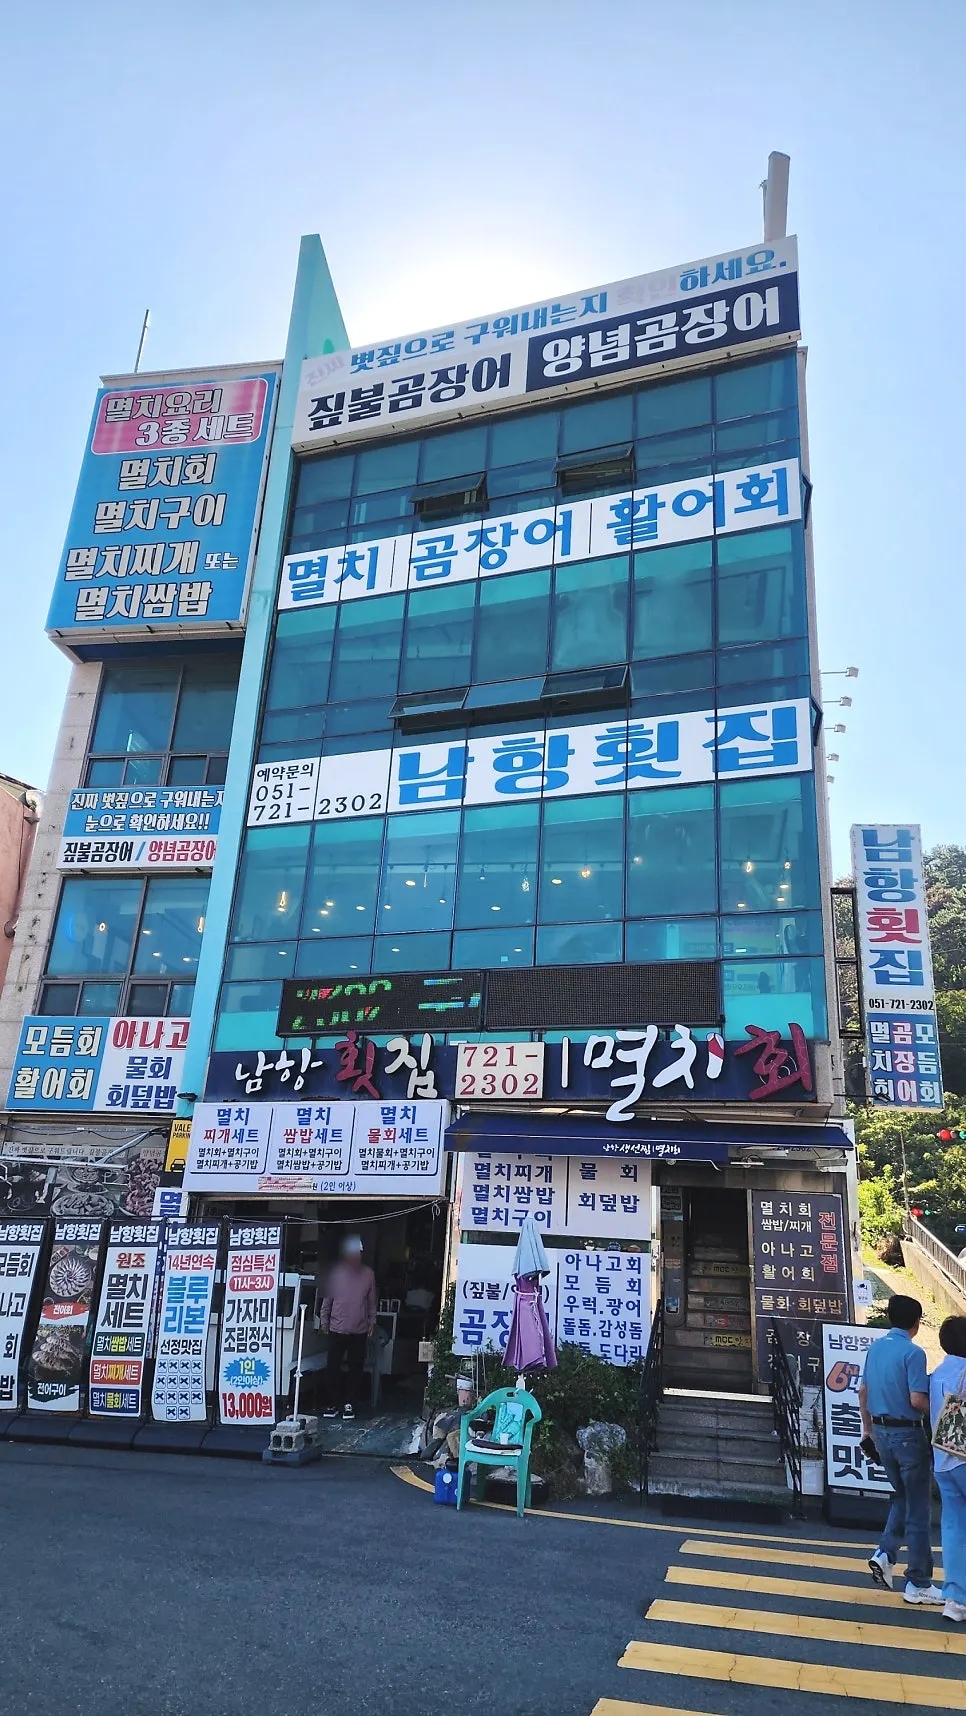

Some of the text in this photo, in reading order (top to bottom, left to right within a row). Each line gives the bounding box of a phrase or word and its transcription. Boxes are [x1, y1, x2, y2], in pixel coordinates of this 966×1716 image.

[350, 330, 455, 374] 볏짚으로
[464, 291, 608, 346] 구워내는지
[541, 286, 781, 378] 양념곰장어
[308, 352, 512, 432] 짚불곰장어
[105, 388, 224, 422] 멸치요리
[135, 412, 255, 446] 3종 세트
[117, 452, 218, 491] 멸치회
[93, 493, 228, 534] 멸치구이
[288, 467, 790, 602] 멸치 곰장어 활어회
[64, 540, 240, 581] 멸치찌개 또는
[74, 581, 213, 621] 멸치쌈밥
[398, 705, 799, 805] 남항횟집
[256, 763, 315, 782] 예약문의
[71, 792, 99, 810] 진짜
[255, 783, 311, 802] 051-
[85, 814, 126, 832] 눈으로
[62, 841, 134, 863] 짚불곰장어
[861, 828, 925, 987] 남항횟집
[868, 998, 935, 1013] 051-721-2302
[22, 1025, 102, 1058] 모듬회
[112, 1020, 191, 1050] 아나고
[125, 1056, 173, 1080] 물회
[14, 1067, 95, 1100] 활어회
[460, 1072, 540, 1097] 2302
[105, 1084, 178, 1110] 회덮밥
[217, 1107, 251, 1126] 멸치
[296, 1107, 331, 1126] 멸치
[380, 1105, 417, 1125] 멸치
[203, 1128, 259, 1144] 찌개세트
[283, 1127, 343, 1144] 쌈밥세트
[367, 1127, 429, 1144] 물회세트
[198, 1147, 260, 1158] 멸치회+멸치구이
[278, 1147, 343, 1159] 멸치회+멸치구이
[196, 1159, 259, 1170] 멸치찌개+공기밥
[276, 1160, 343, 1171] 멸치쌈밥+공기밥
[361, 1159, 430, 1171] 멸치찌개+공기밥
[474, 1162, 553, 1184] 멸치찌개
[472, 1184, 555, 1206] 멸치쌈밥
[578, 1192, 640, 1214] 회덮밥
[471, 1206, 552, 1228] 멸치구이
[760, 1200, 812, 1218] 멸치회
[55, 1223, 102, 1241] 남항횟집
[109, 1224, 160, 1243] 남항횟집
[761, 1218, 813, 1233] 쌈밥/찌개
[168, 1227, 219, 1246] 남항횟집
[230, 1226, 280, 1246] 남항횟집
[818, 1211, 839, 1274] 전문점
[761, 1241, 815, 1258] 아나고
[116, 1252, 146, 1270] 원조
[168, 1254, 215, 1271] 14년연속
[231, 1254, 276, 1272] 점심특선
[564, 1253, 641, 1275] 아나고회
[233, 1276, 270, 1289] 11시~3시
[762, 1263, 815, 1282] 활어회
[106, 1273, 149, 1300] 멸치
[167, 1276, 209, 1304] 블루
[101, 1301, 145, 1329] 세트
[164, 1305, 206, 1334] 리본
[226, 1298, 274, 1324] 가자미
[96, 1335, 142, 1353] 멸치쌈밥세트
[160, 1339, 203, 1355] 선정맛집
[223, 1326, 273, 1353] 조림정식
[93, 1363, 139, 1381] 멸치찌개세트
[240, 1360, 255, 1374] 1인
[37, 1382, 67, 1396] 전어구이
[92, 1391, 137, 1410] 멸치물회세트
[222, 1392, 273, 1419] 13,000원
